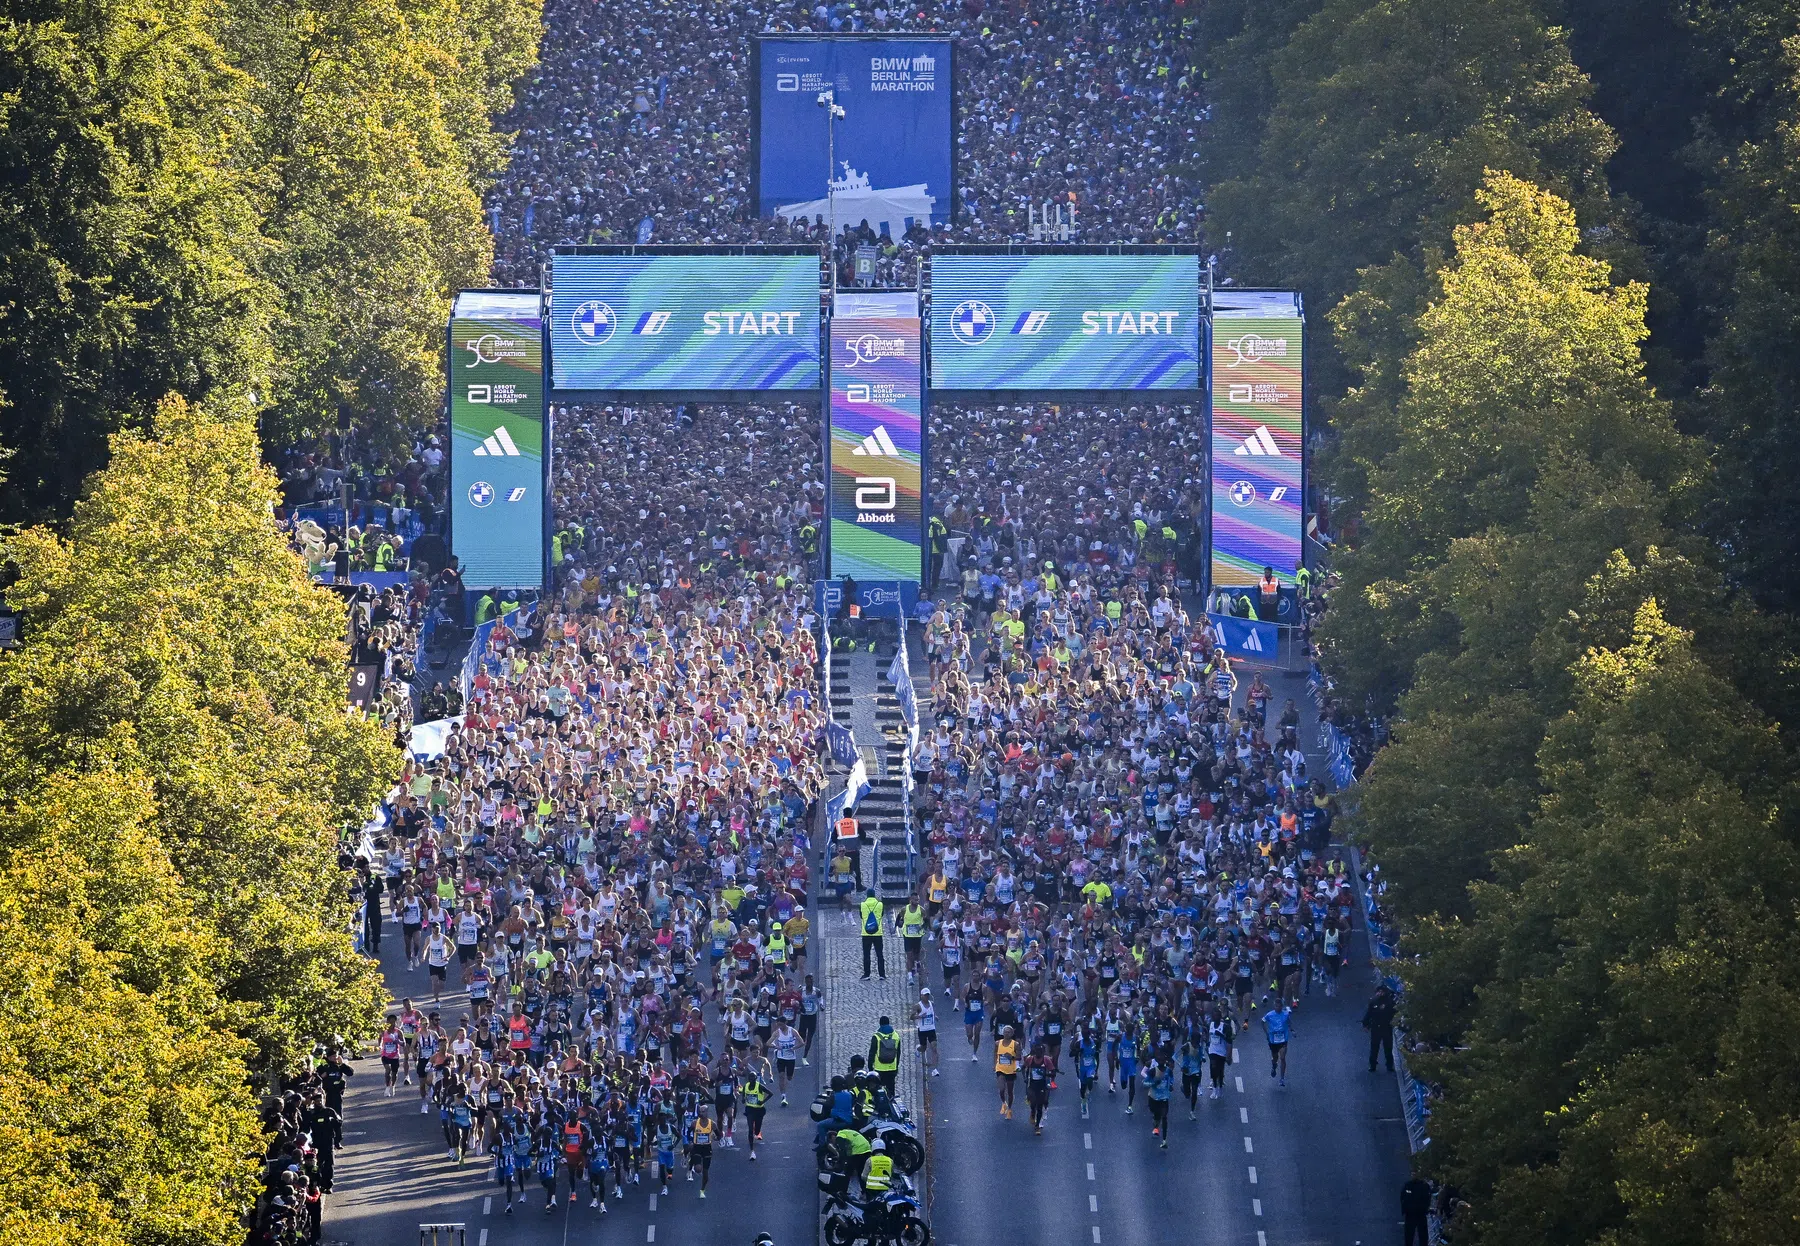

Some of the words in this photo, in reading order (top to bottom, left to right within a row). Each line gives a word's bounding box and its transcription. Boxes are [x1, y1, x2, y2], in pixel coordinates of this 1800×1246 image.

[871, 57, 911, 71] BMW
[871, 71, 911, 81] BERLIN
[871, 82, 935, 92] MARATHON
[860, 258, 871, 273] B
[703, 311, 801, 335] START
[1081, 311, 1180, 335] START
[856, 512, 896, 523] Abbott
[356, 672, 366, 687] 9
